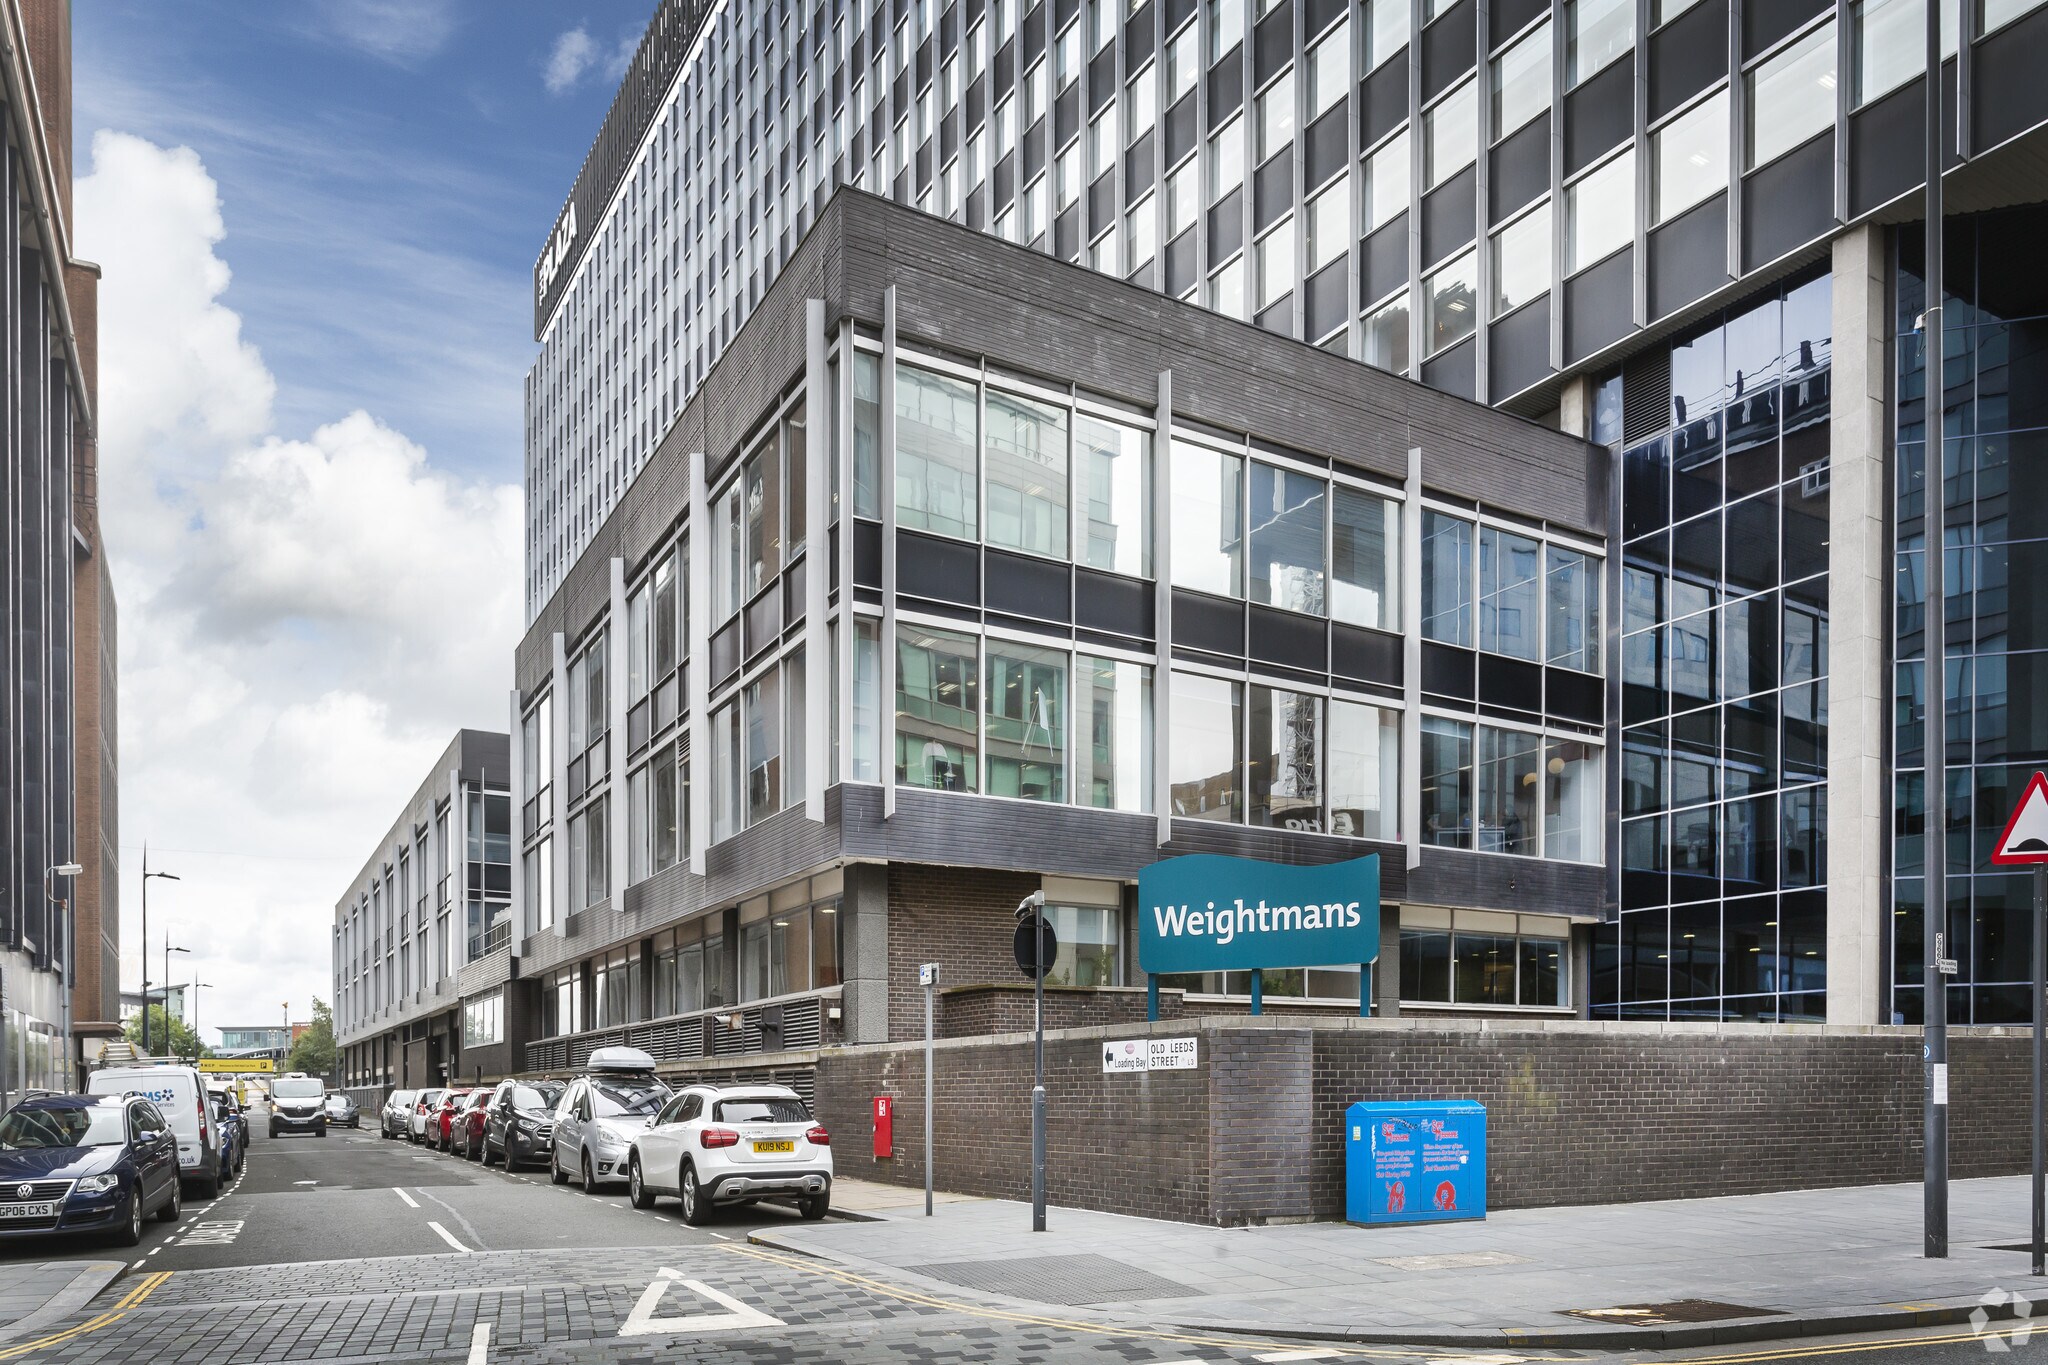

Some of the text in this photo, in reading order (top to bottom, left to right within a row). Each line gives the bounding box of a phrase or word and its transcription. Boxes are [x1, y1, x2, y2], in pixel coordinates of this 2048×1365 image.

[543, 201, 577, 299] PLAZA
[1153, 899, 1361, 945] Weightmans
[1150, 1041, 1194, 1054] OLD LEEDS
[1114, 1057, 1146, 1070] Loading Bay
[1151, 1056, 1179, 1067] STREET
[757, 1142, 790, 1151] KU19 NSJ
[0, 1205, 49, 1217] GP06 CXS
